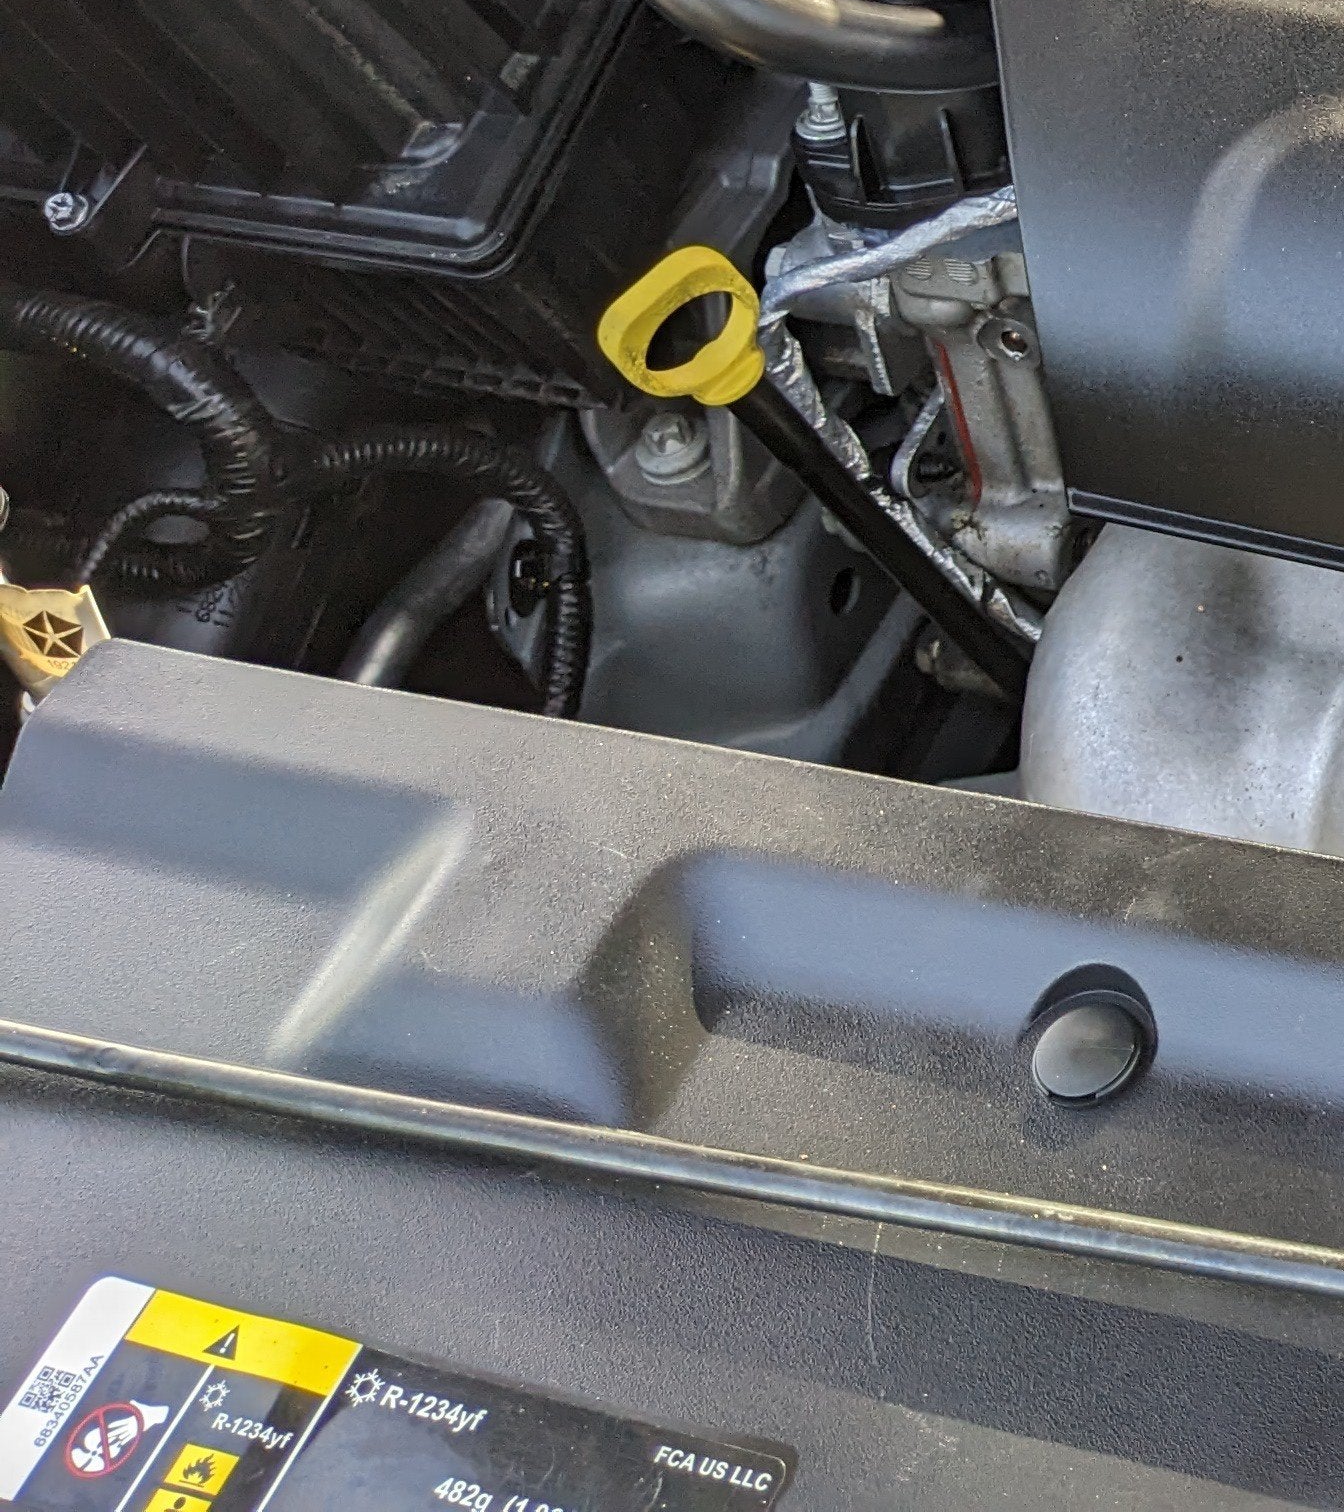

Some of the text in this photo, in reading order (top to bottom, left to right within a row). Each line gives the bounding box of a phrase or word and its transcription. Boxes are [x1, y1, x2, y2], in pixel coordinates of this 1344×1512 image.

[33, 1354, 104, 1448] 68340587AA
[379, 1384, 489, 1433] R-1234yf
[211, 1412, 294, 1450] R-1234yf
[653, 1445, 773, 1492] FCA US LLC
[433, 1477, 493, 1512] 482g
